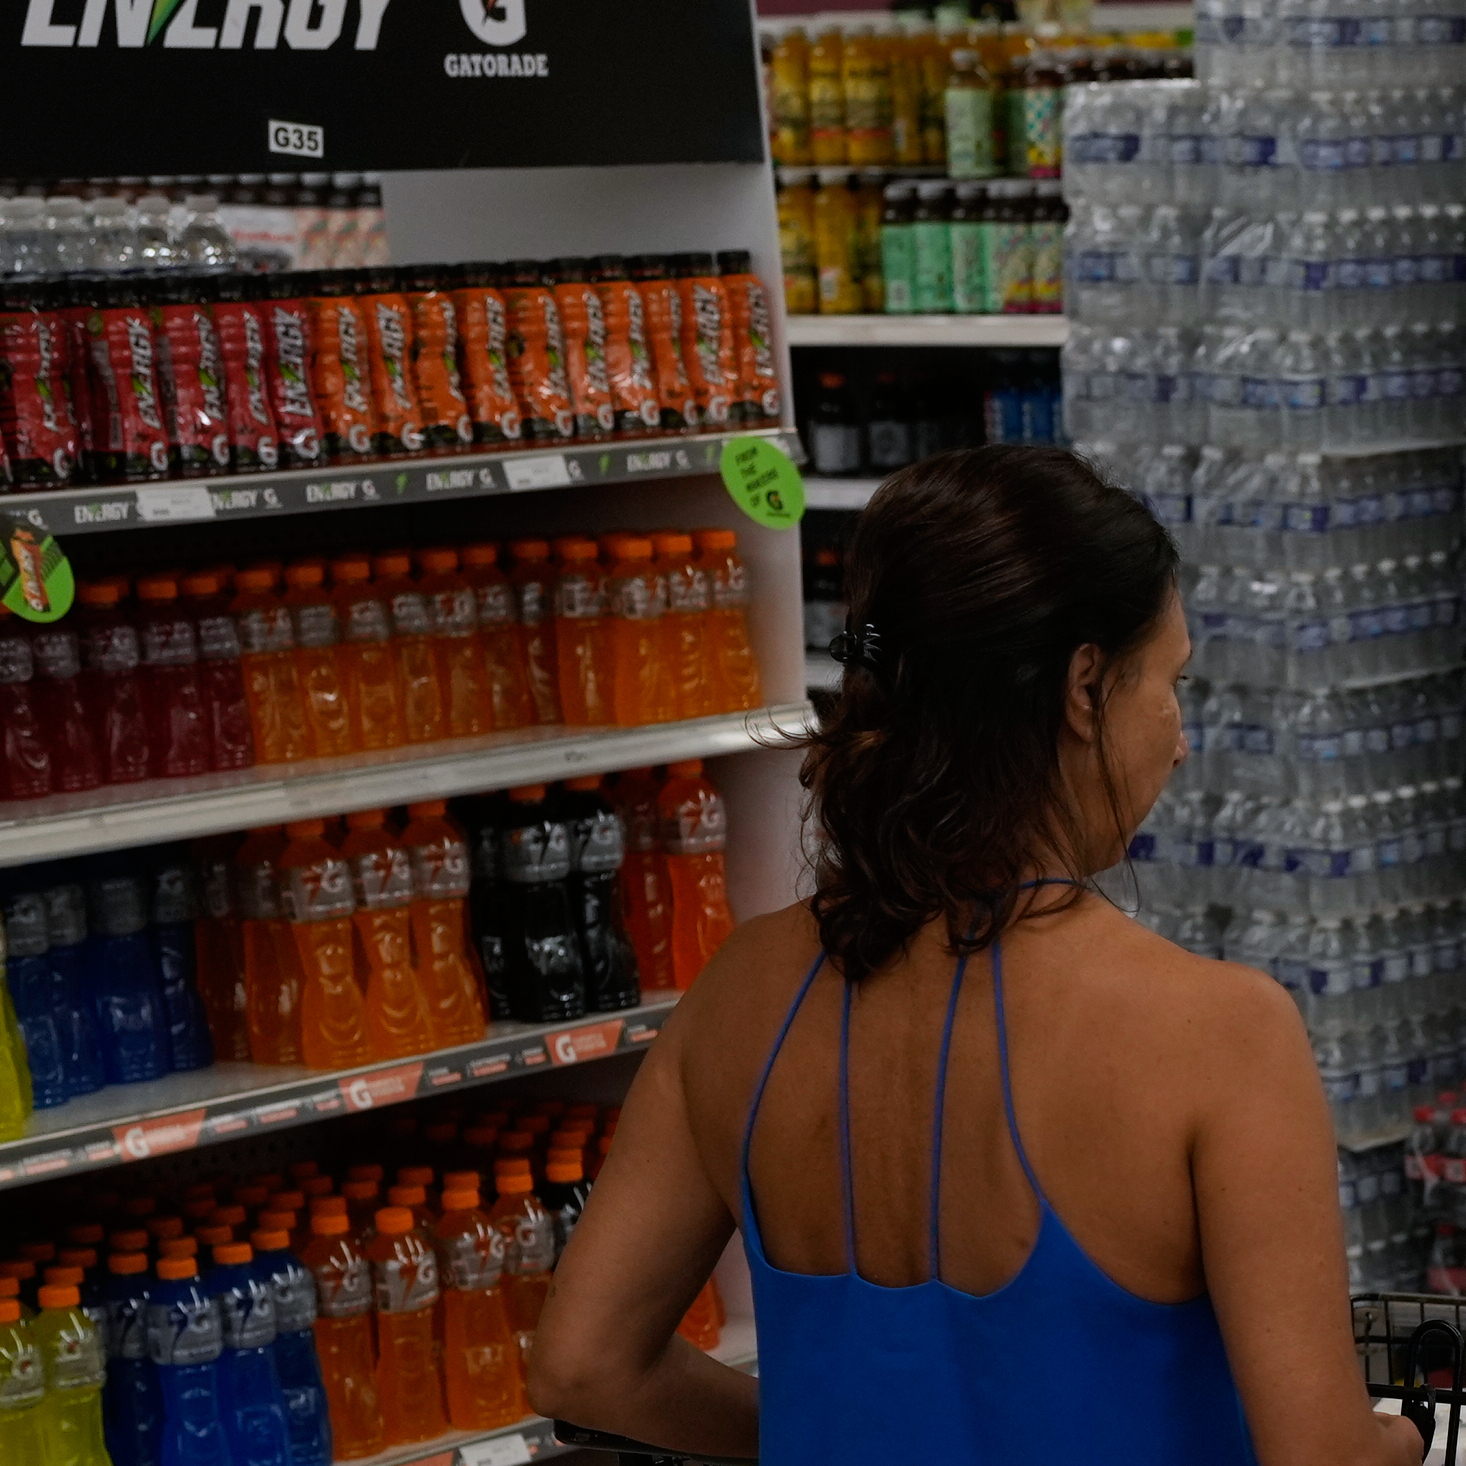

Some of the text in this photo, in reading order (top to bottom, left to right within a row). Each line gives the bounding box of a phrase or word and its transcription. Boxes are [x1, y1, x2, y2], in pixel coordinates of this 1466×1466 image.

[443, 52, 549, 78] GATORADE
[273, 126, 321, 152] G35
[306, 481, 357, 503] ENERGY
[74, 502, 129, 524] ENERGY
[555, 1035, 577, 1063] G
[350, 1080, 374, 1108] G
